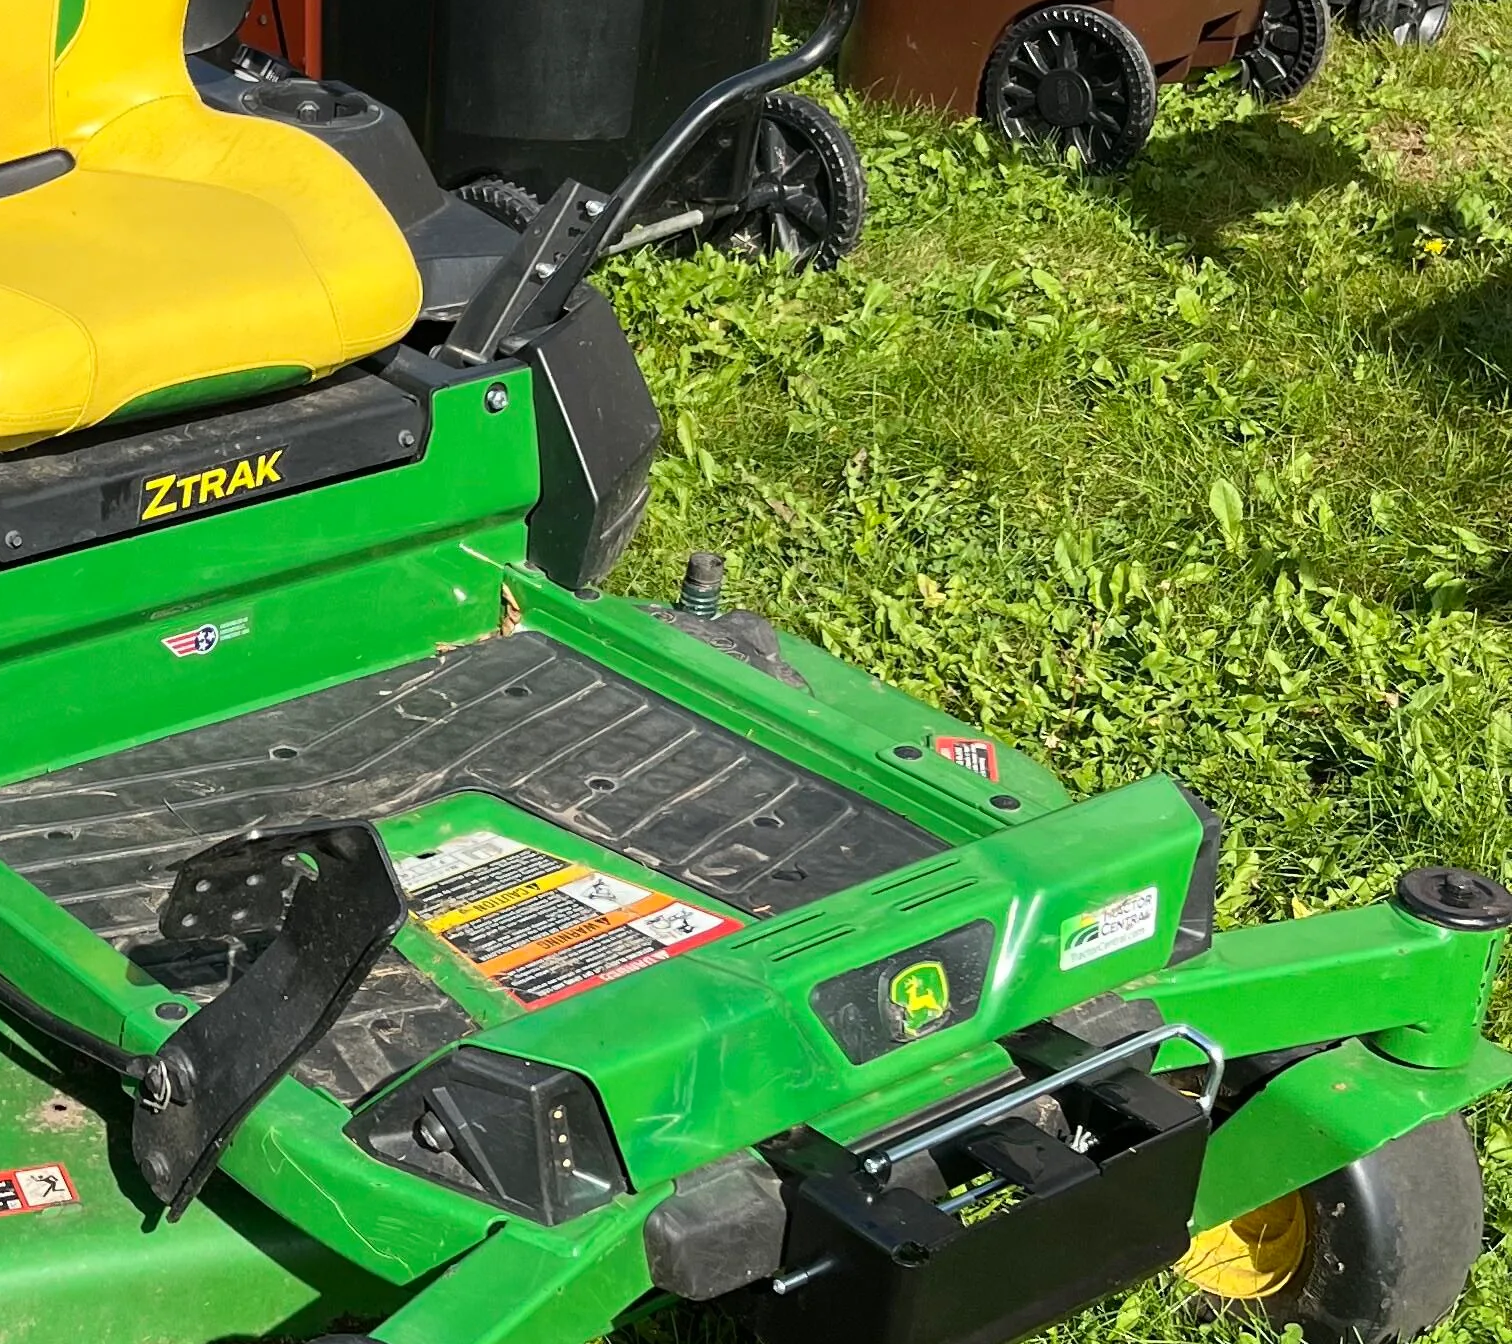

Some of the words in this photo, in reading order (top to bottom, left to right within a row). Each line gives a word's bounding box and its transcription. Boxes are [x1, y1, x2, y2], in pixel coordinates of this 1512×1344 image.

[141, 449, 284, 521] ZTRAK
[472, 885, 530, 913] CAUTION
[538, 921, 598, 951] WARNING
